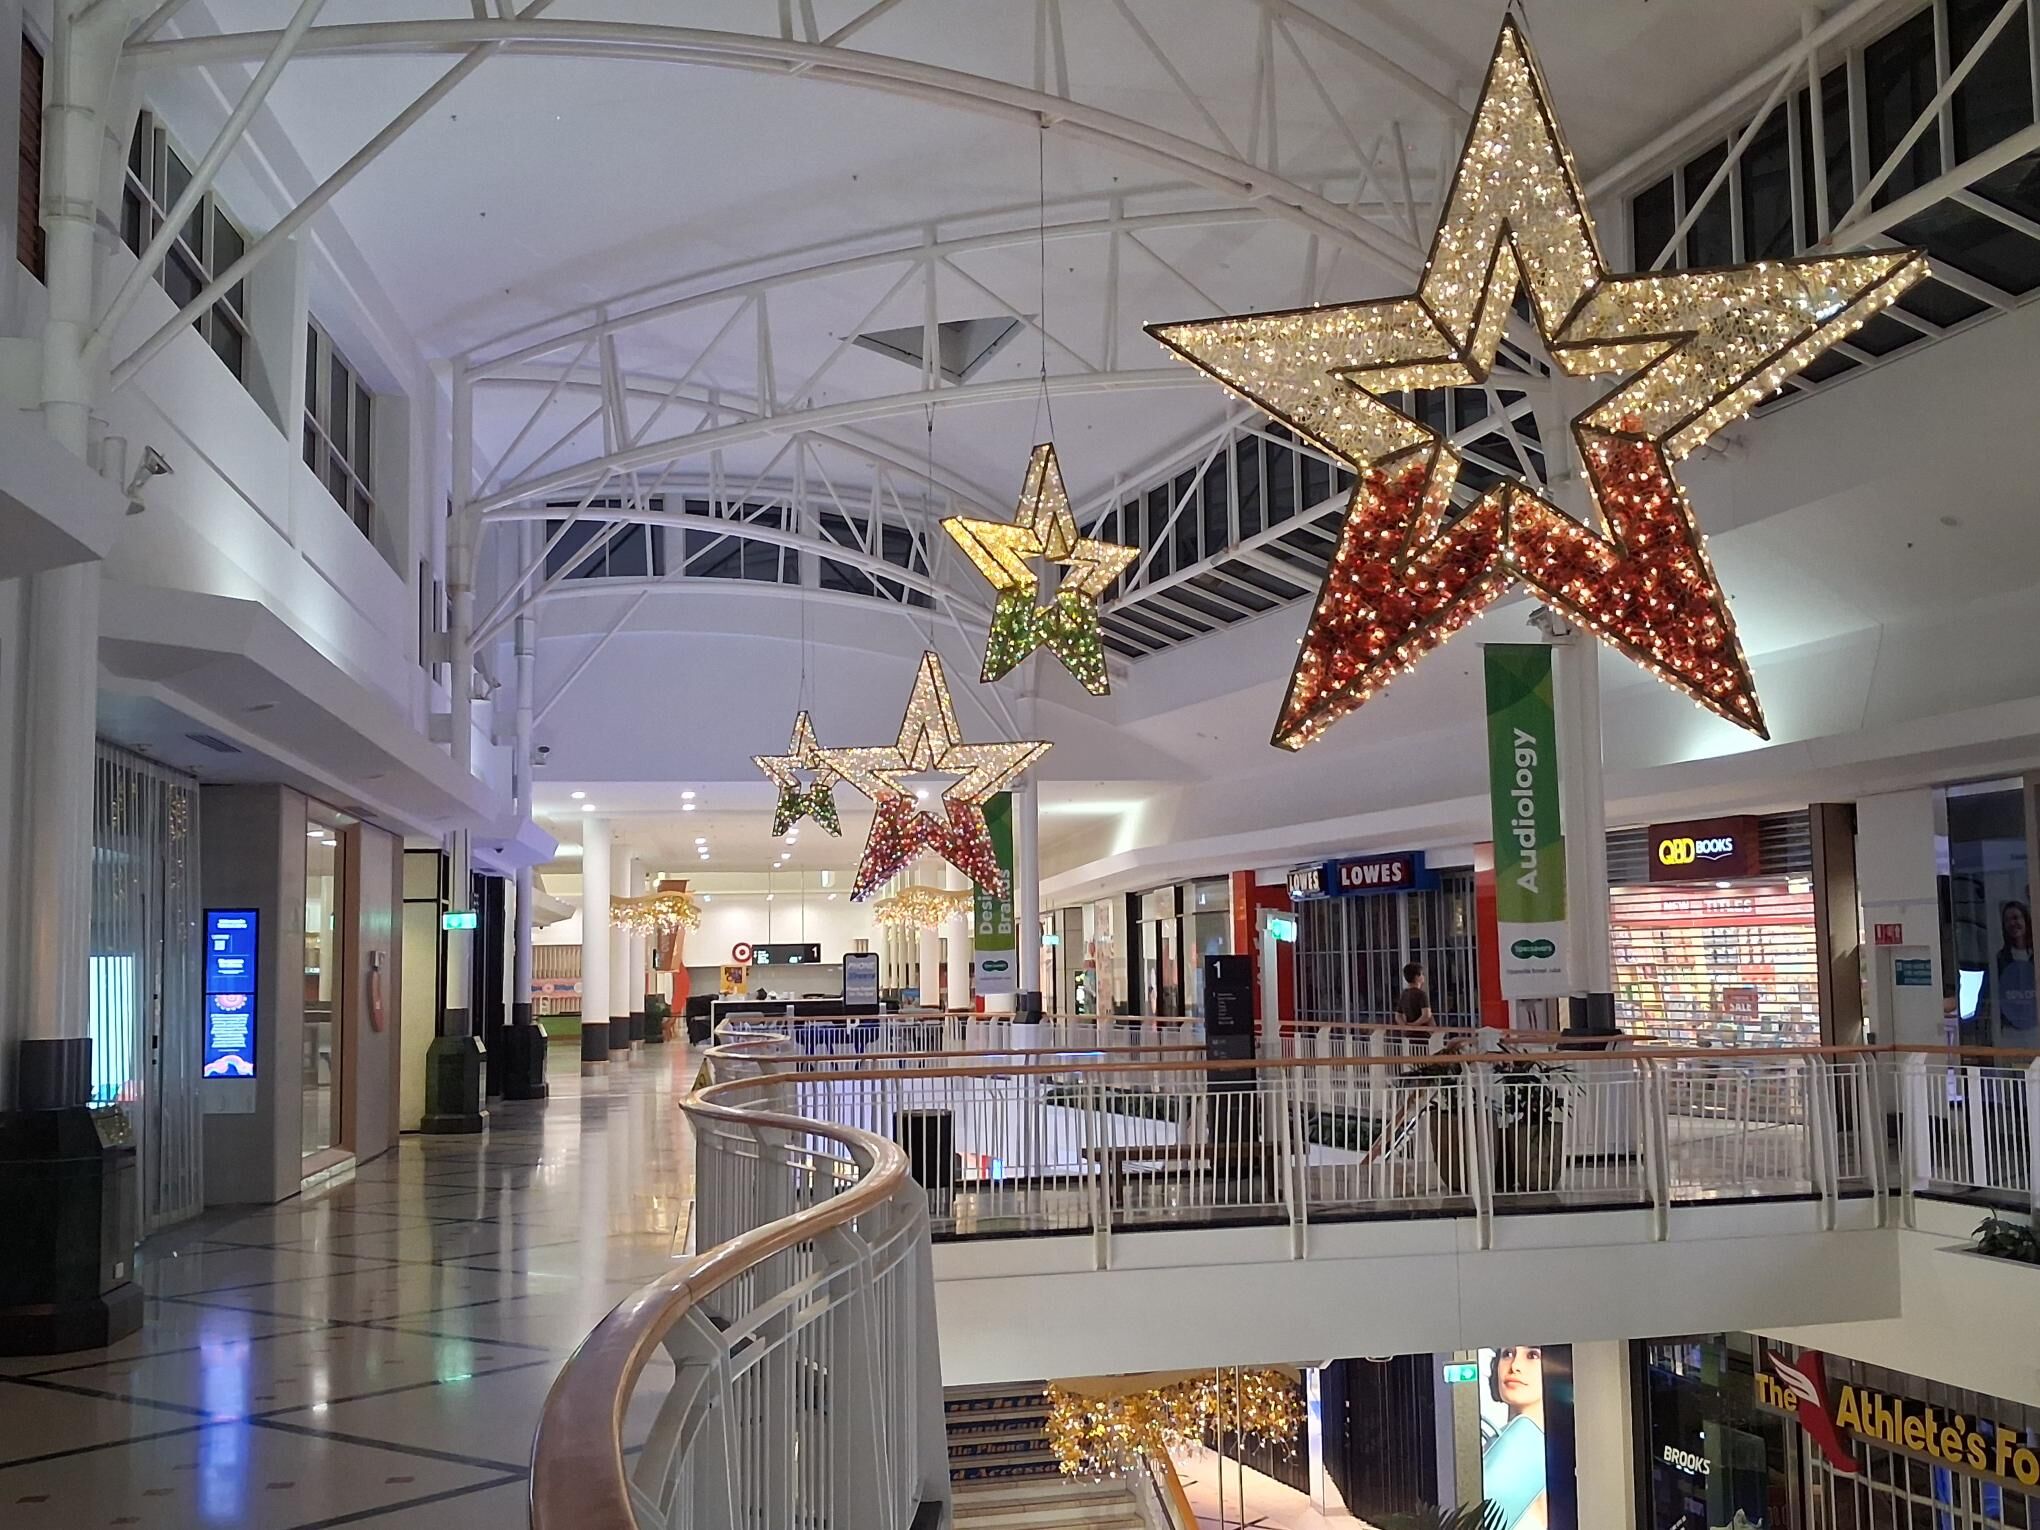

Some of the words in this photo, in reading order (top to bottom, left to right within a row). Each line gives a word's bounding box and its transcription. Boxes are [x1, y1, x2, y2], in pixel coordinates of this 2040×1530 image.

[1511, 727, 1538, 894] Audiology
[1659, 838, 1695, 865] QBD
[1696, 838, 1733, 854] BOOKS
[1289, 870, 1320, 892] LOWES
[1341, 862, 1402, 887] LOWES
[811, 946, 818, 959] 1
[1212, 960, 1222, 979] 1
[1729, 1002, 1752, 1012] SALE
[1755, 1373, 1798, 1411] The
[1836, 1385, 1987, 1471] Athlete's
[1663, 1445, 1711, 1475] BROOKS
